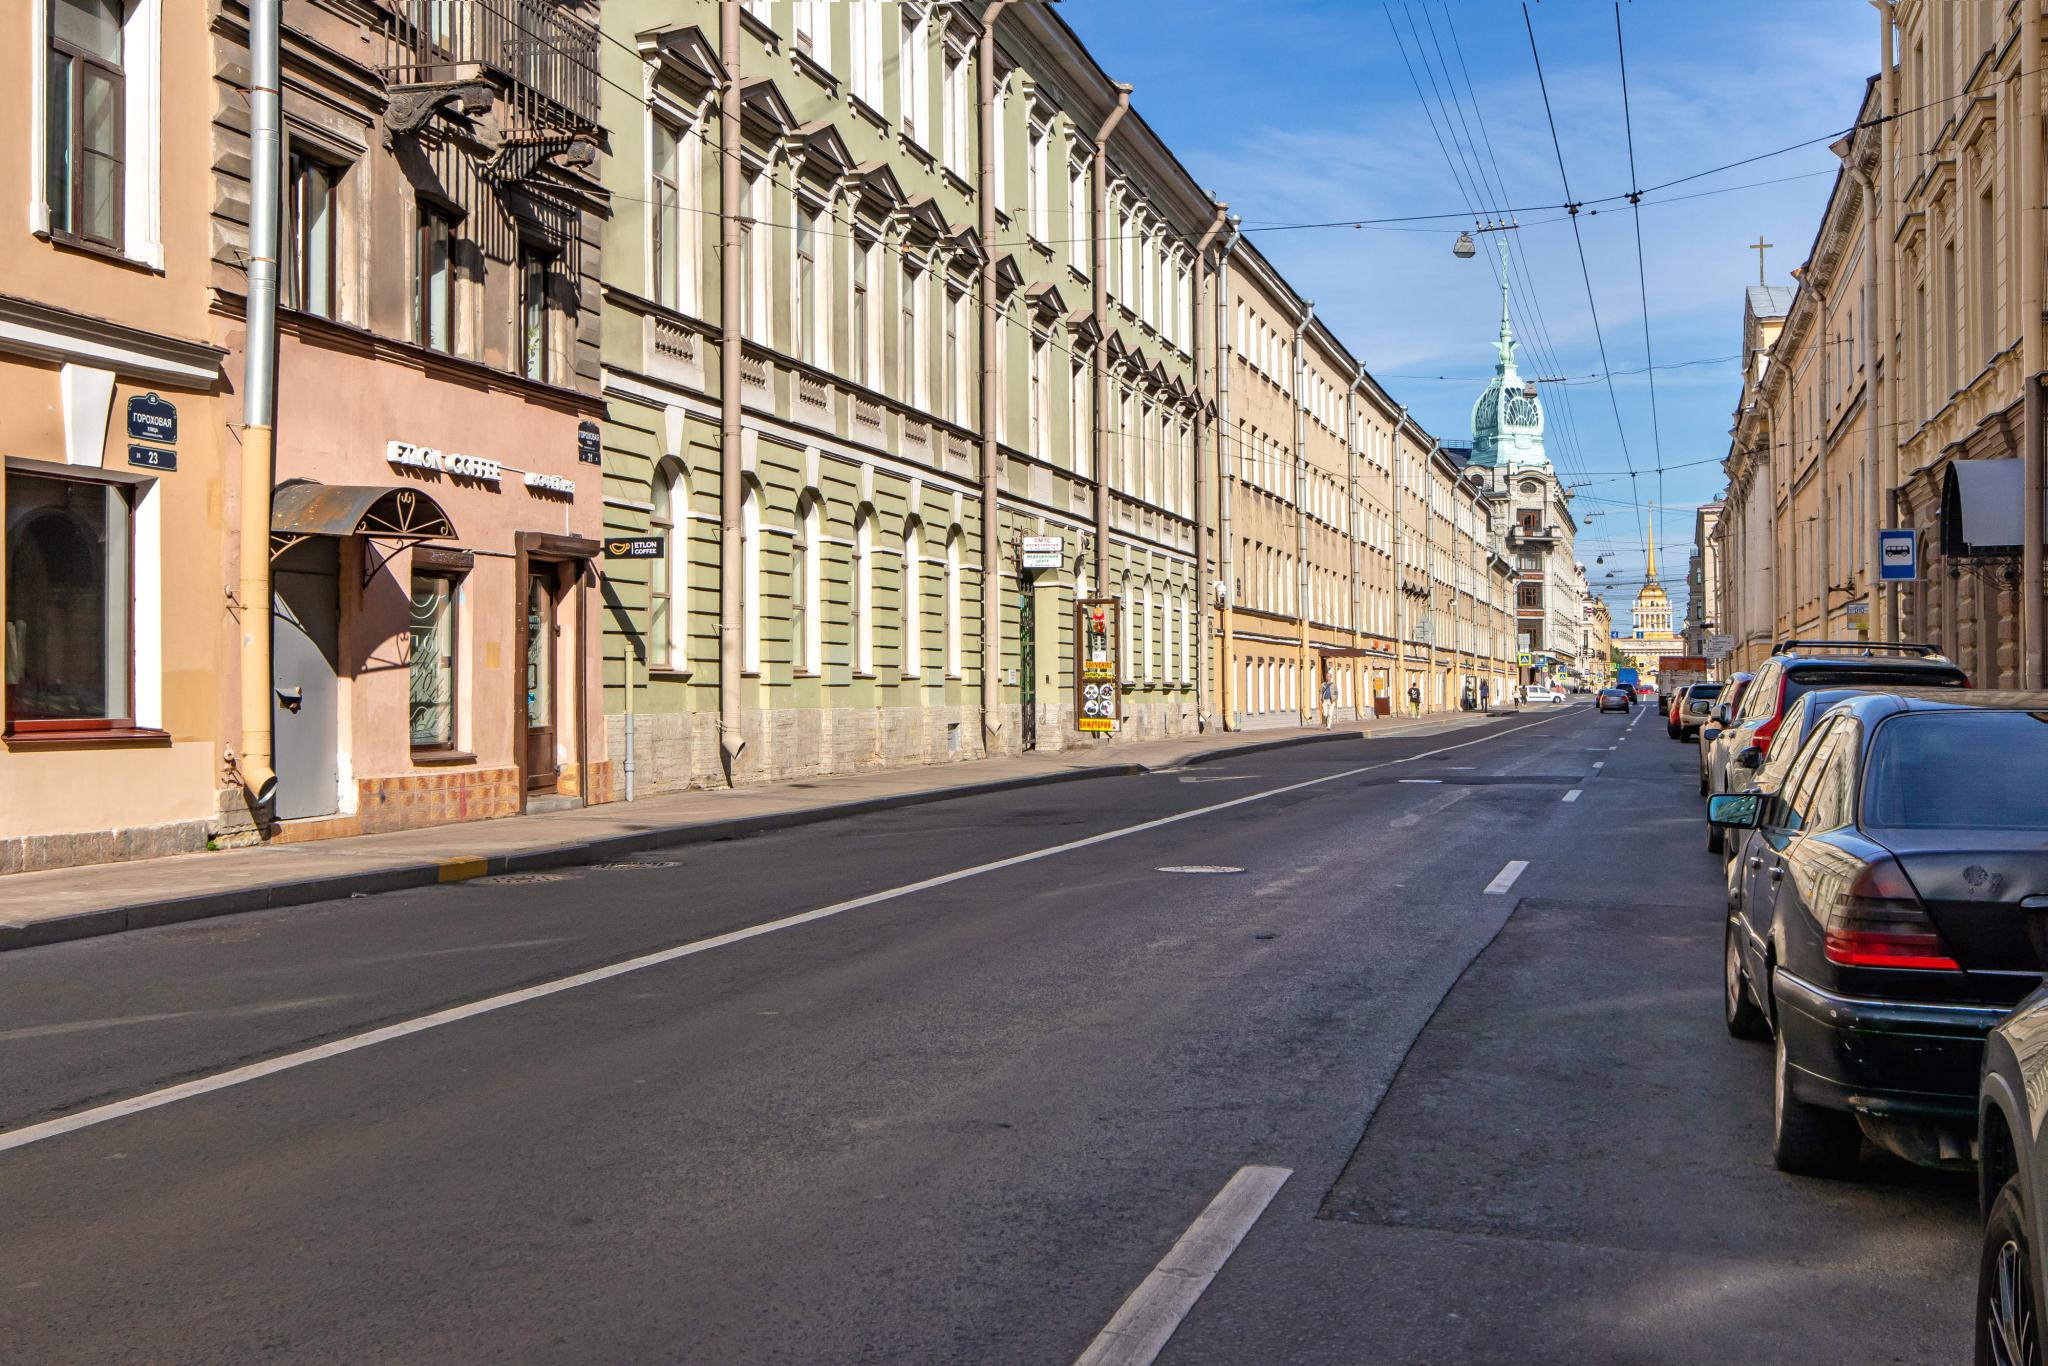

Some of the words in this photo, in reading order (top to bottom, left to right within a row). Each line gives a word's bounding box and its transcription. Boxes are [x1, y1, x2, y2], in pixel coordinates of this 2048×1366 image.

[133, 412, 172, 428] ГОРОХОВАЯ
[579, 431, 600, 441] ГОРОХОВАЯ
[148, 451, 159, 464] 23
[586, 453, 593, 463] 21
[445, 453, 502, 480] COFFEE
